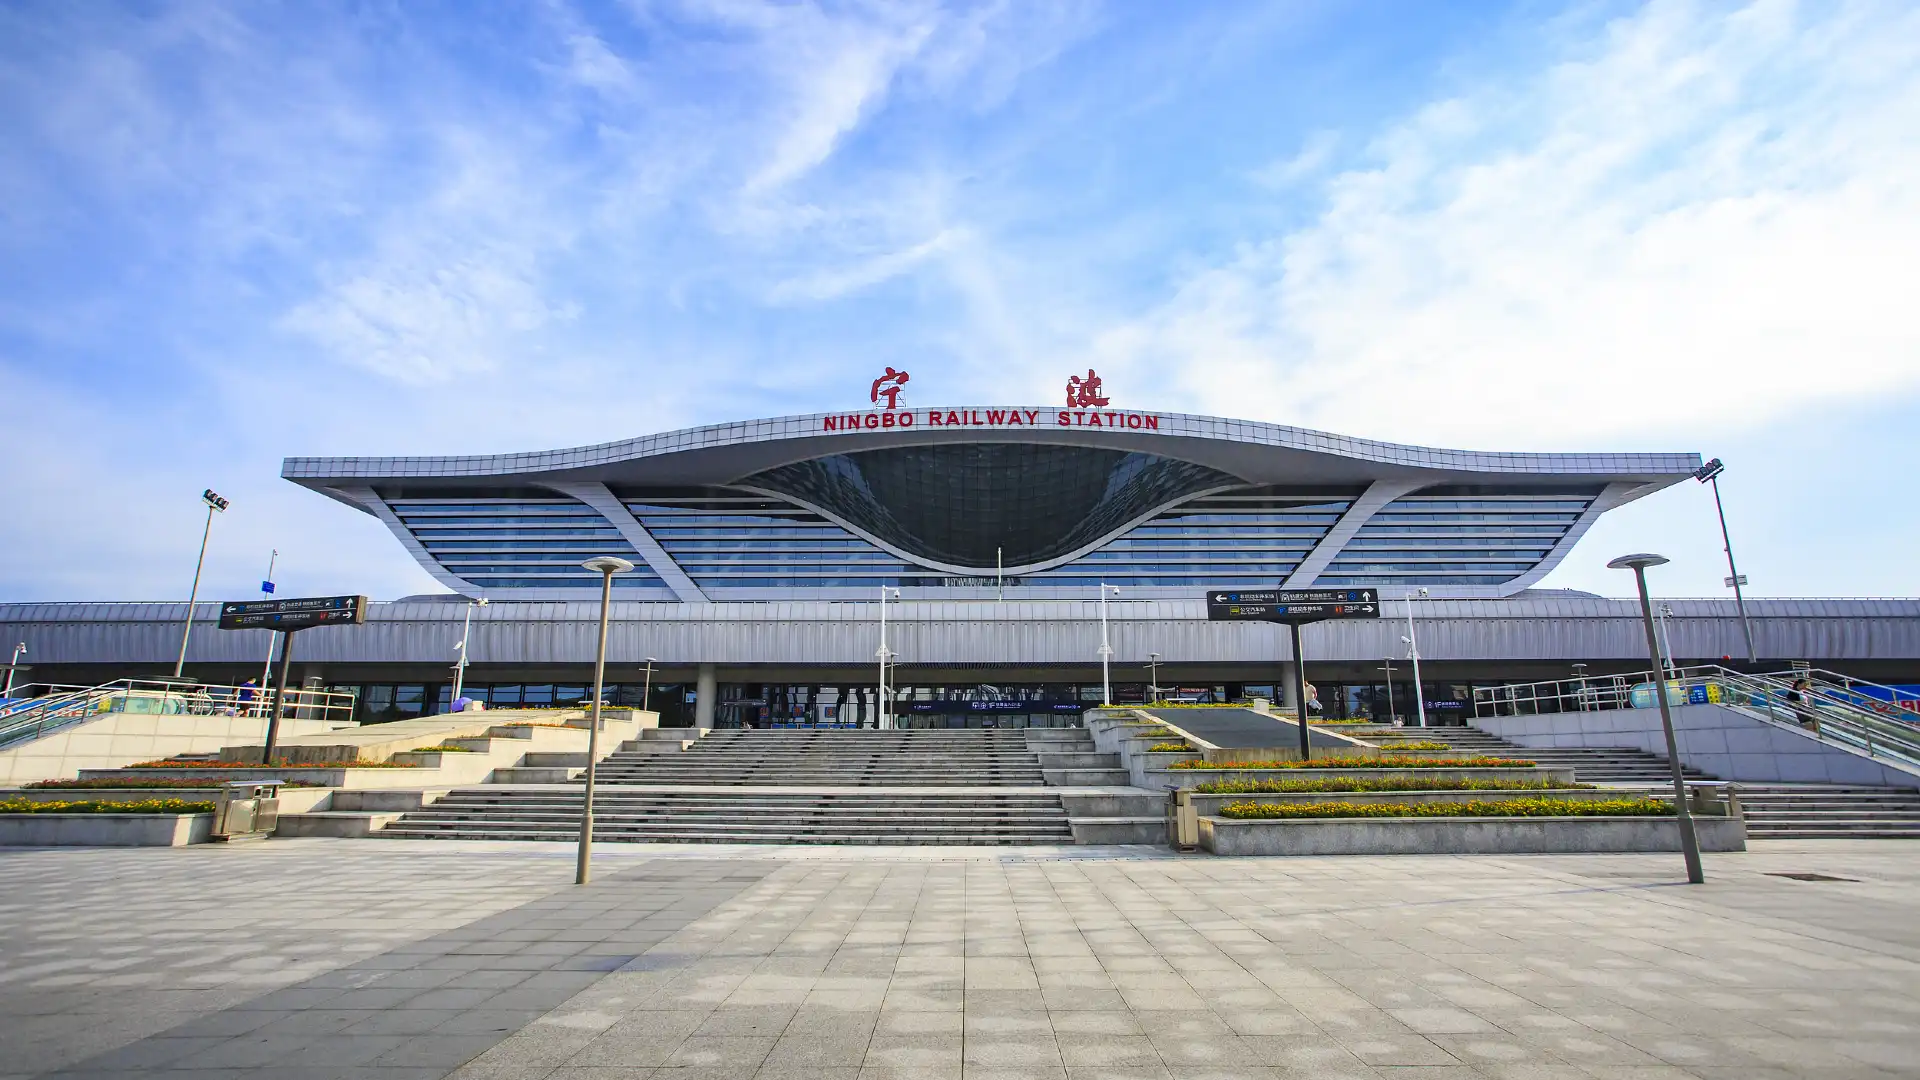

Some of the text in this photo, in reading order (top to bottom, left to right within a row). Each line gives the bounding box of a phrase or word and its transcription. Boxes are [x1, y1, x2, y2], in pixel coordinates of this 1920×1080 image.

[871, 366, 1110, 409] 宁 波
[823, 410, 1159, 431] NINGBO RAILWAY STATION
